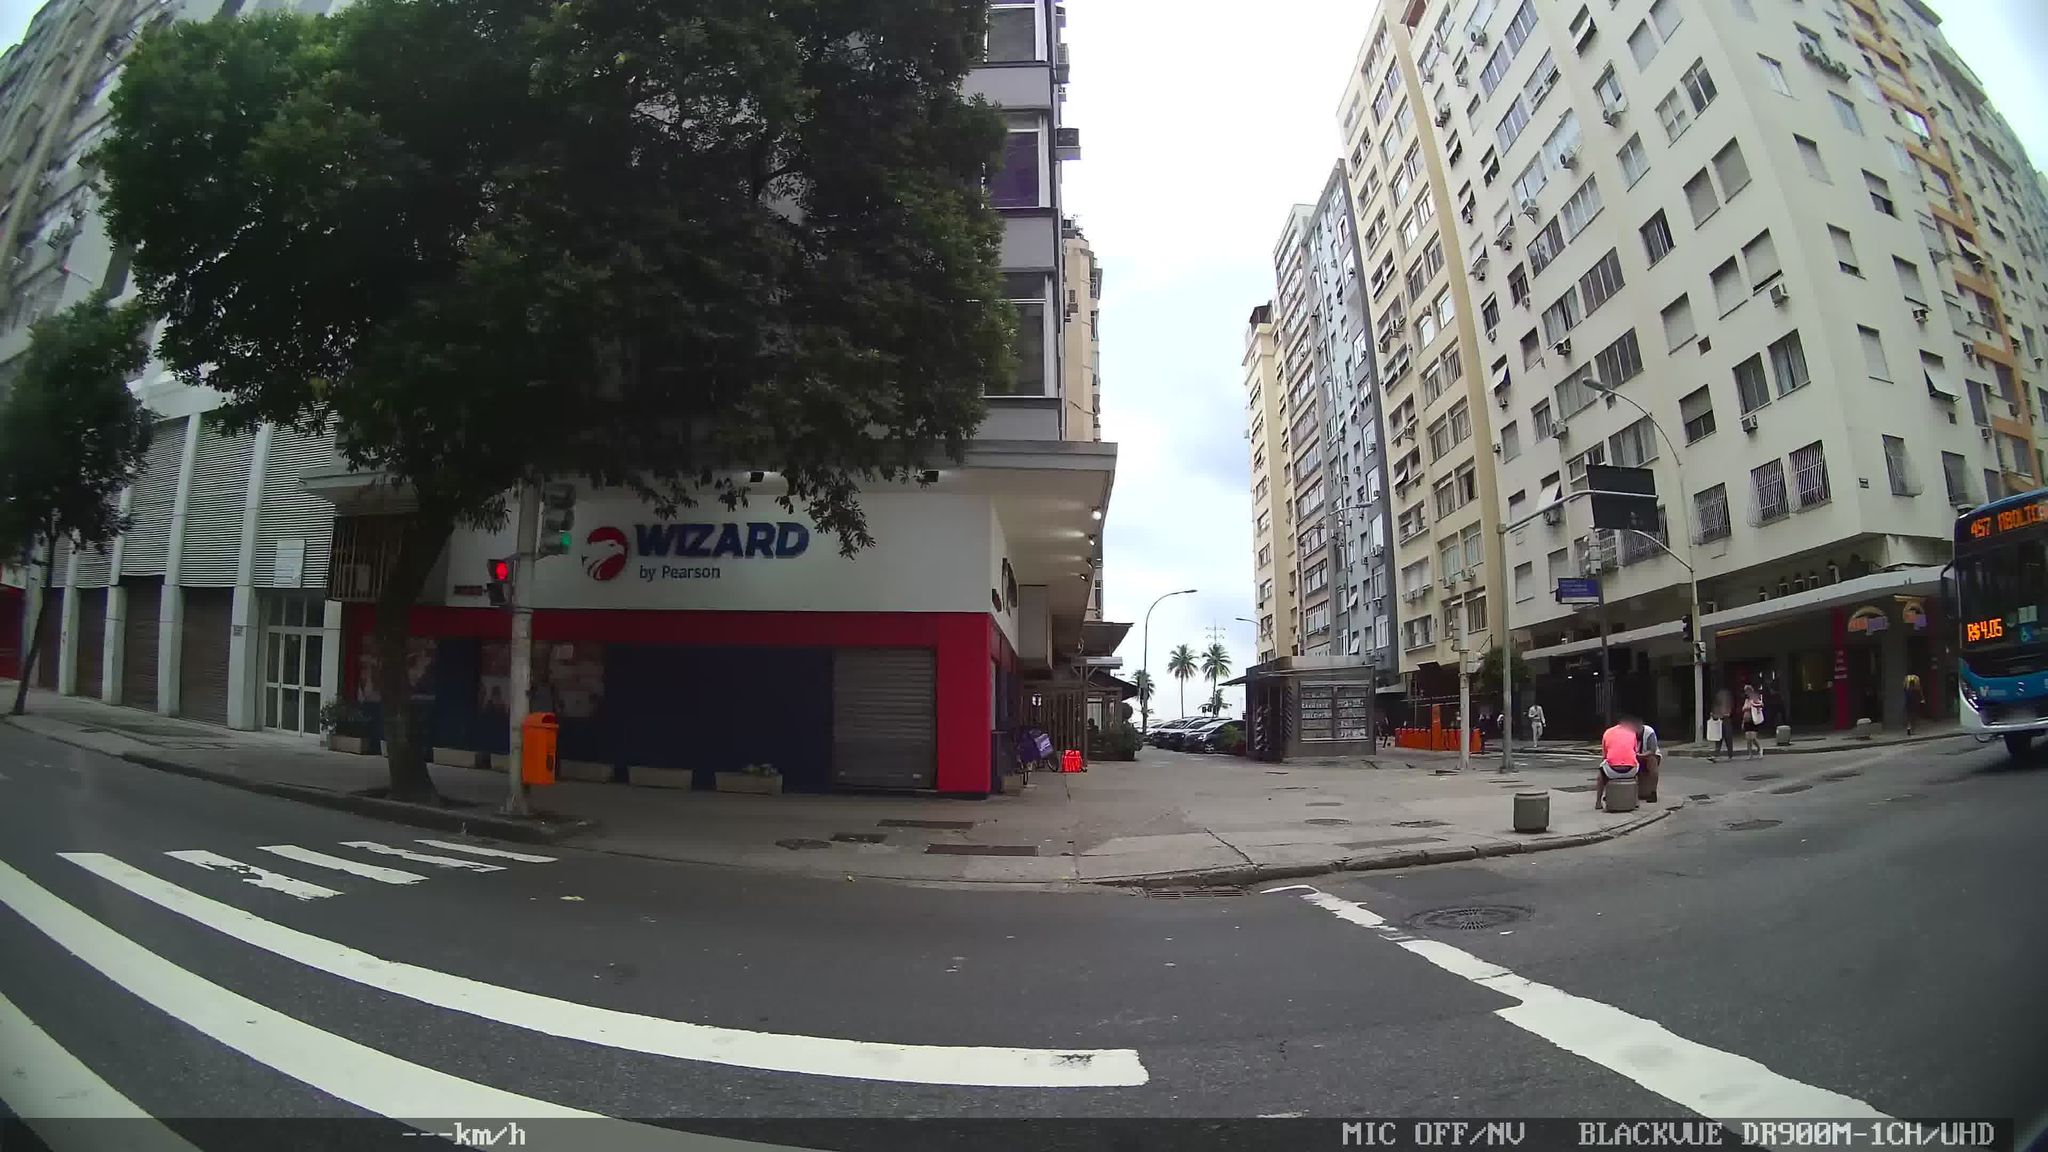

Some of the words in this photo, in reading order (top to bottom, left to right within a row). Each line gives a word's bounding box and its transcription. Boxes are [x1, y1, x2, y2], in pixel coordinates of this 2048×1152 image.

[1970, 517, 1991, 538] 457
[634, 522, 810, 559] WIZARD
[639, 565, 656, 582] by
[662, 565, 721, 579] Pearson
